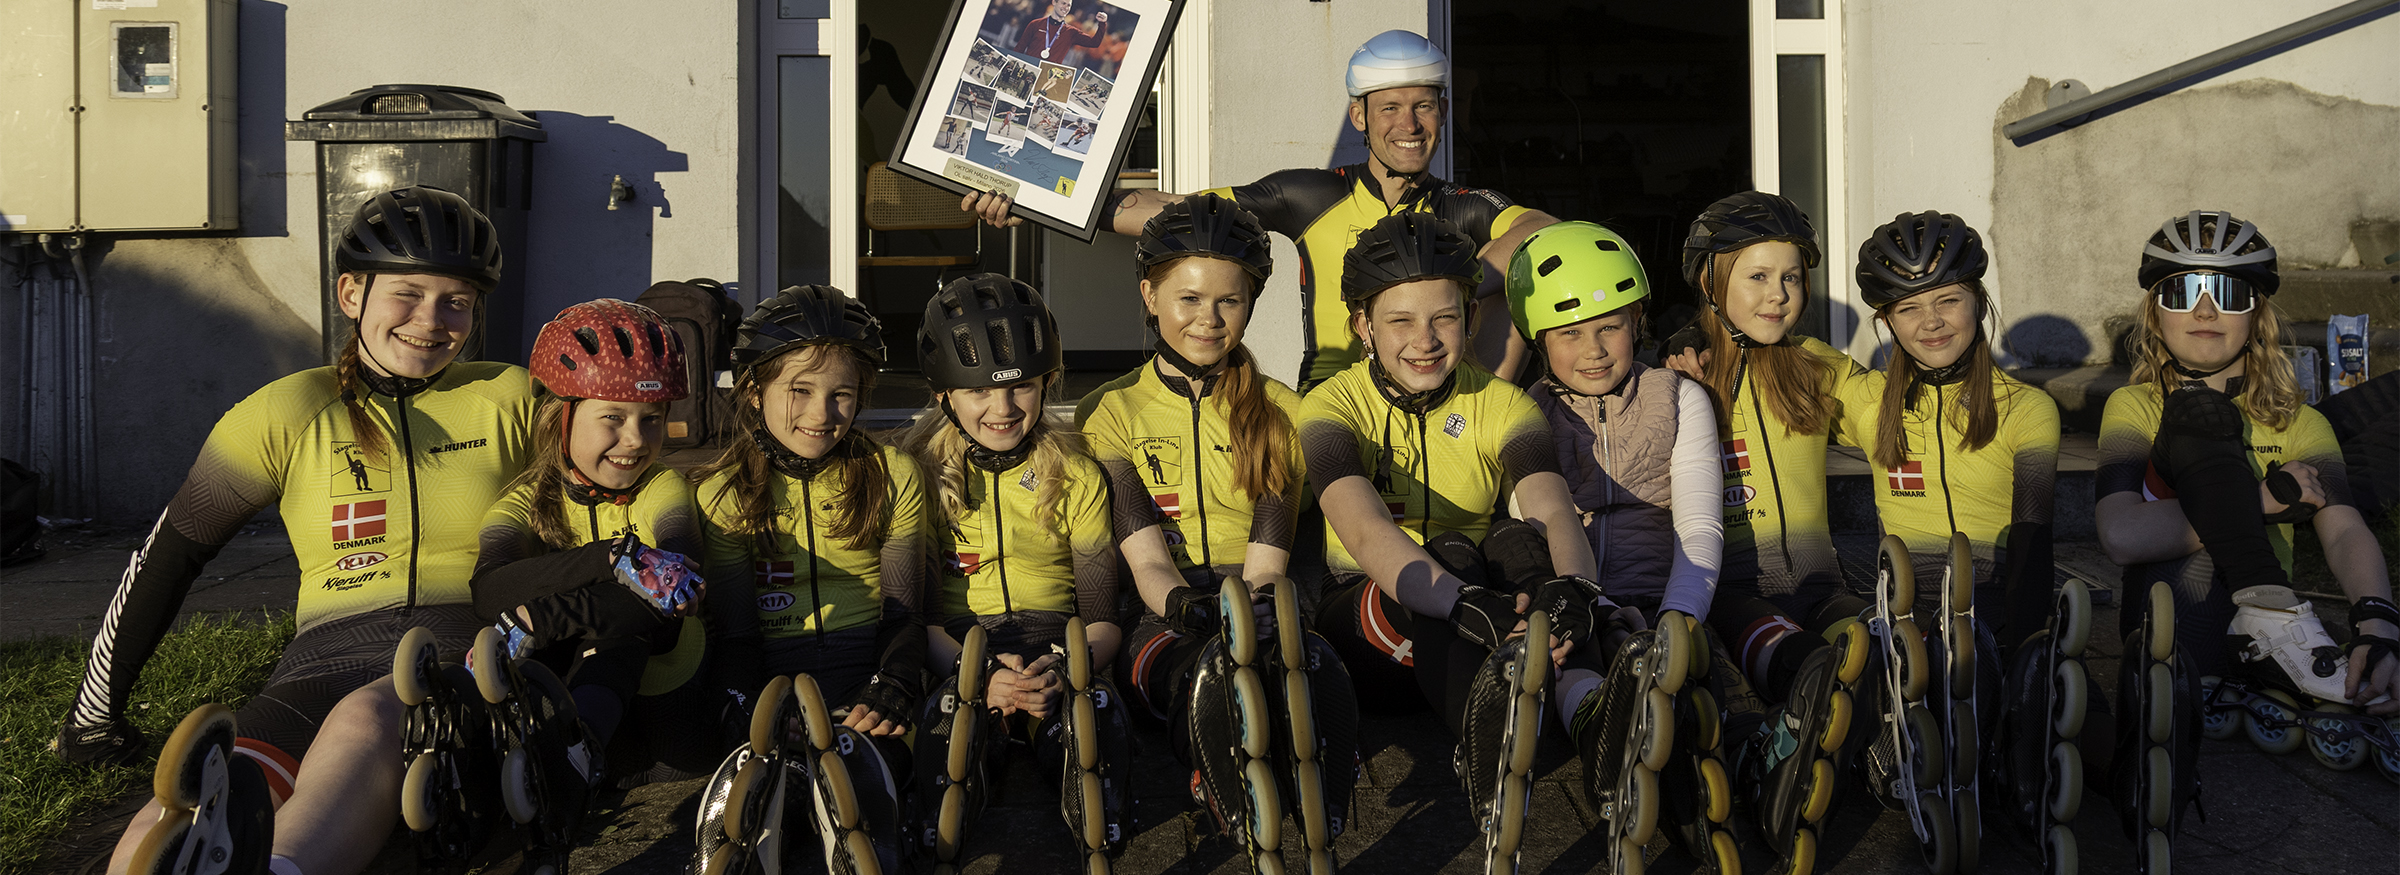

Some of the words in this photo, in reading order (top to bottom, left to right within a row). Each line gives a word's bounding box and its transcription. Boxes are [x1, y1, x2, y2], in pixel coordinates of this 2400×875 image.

[953, 163, 973, 174] VIKTOR
[973, 171, 989, 180] HALD
[989, 176, 1012, 188] THORUP
[996, 370, 1019, 380] ABUS
[444, 438, 487, 452] HUNTER
[1723, 469, 1752, 480] NMARK
[1723, 508, 1754, 524] erulff
[333, 535, 386, 550] DENMARK
[321, 571, 378, 591] Kjerulff
[380, 571, 391, 579] A/S
